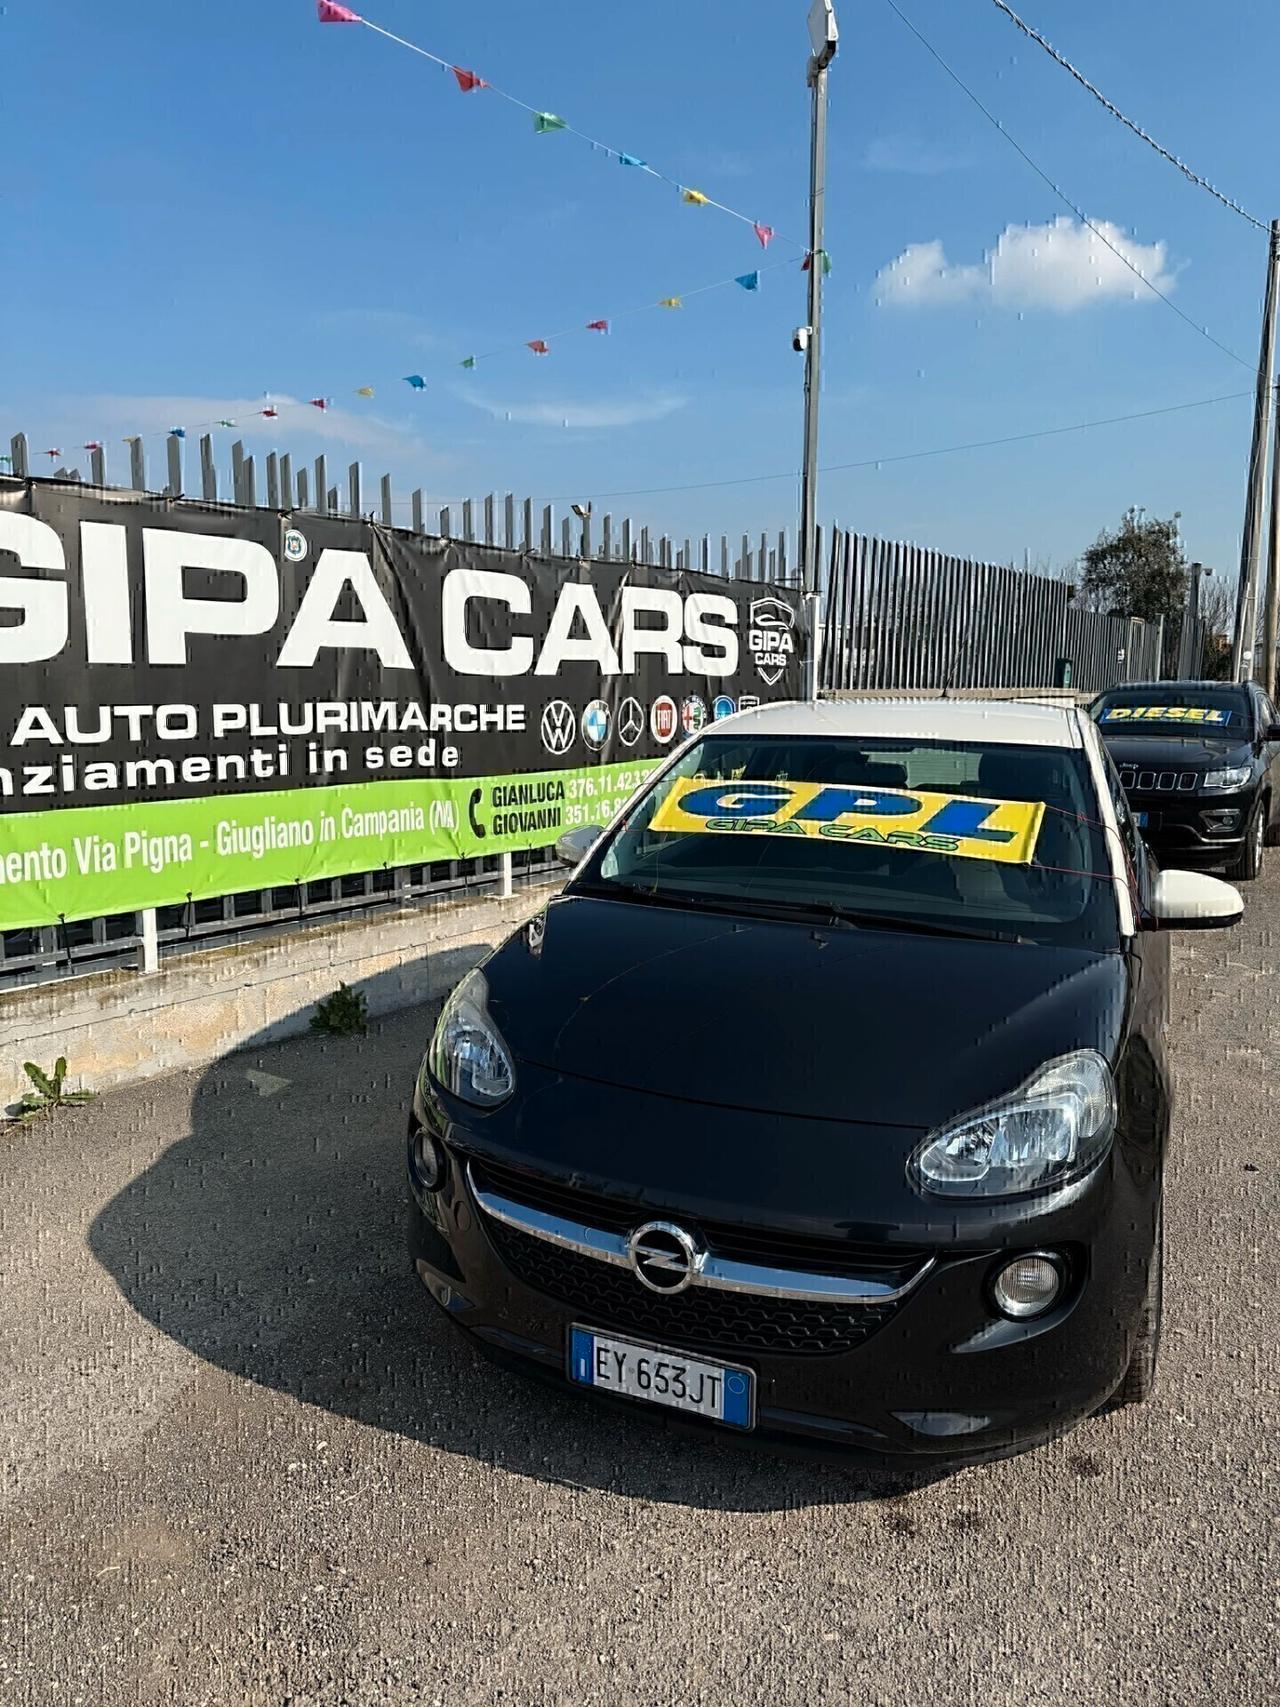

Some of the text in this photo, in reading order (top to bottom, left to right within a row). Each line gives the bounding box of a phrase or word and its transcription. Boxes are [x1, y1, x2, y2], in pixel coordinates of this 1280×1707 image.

[0, 510, 739, 676] GIPA CARS
[749, 629, 794, 653] GIPA
[755, 652, 787, 666] CARS
[10, 700, 526, 747] AUTO PLURIMARCHE
[1106, 707, 1224, 722] DIESEL
[308, 742, 348, 775] in
[366, 738, 459, 769] sede
[492, 780, 565, 808] GIANLUCA
[493, 807, 561, 836] GIOVANNI
[678, 784, 1019, 844] GPL
[73, 833, 116, 875] Via
[124, 830, 193, 874] Pigna
[216, 815, 314, 859] Giugliano
[320, 810, 336, 842] in
[341, 801, 424, 841] Campania
[705, 818, 961, 852] GIPA CARS
[596, 1346, 627, 1384] EY
[637, 1358, 722, 1408] 653JT
